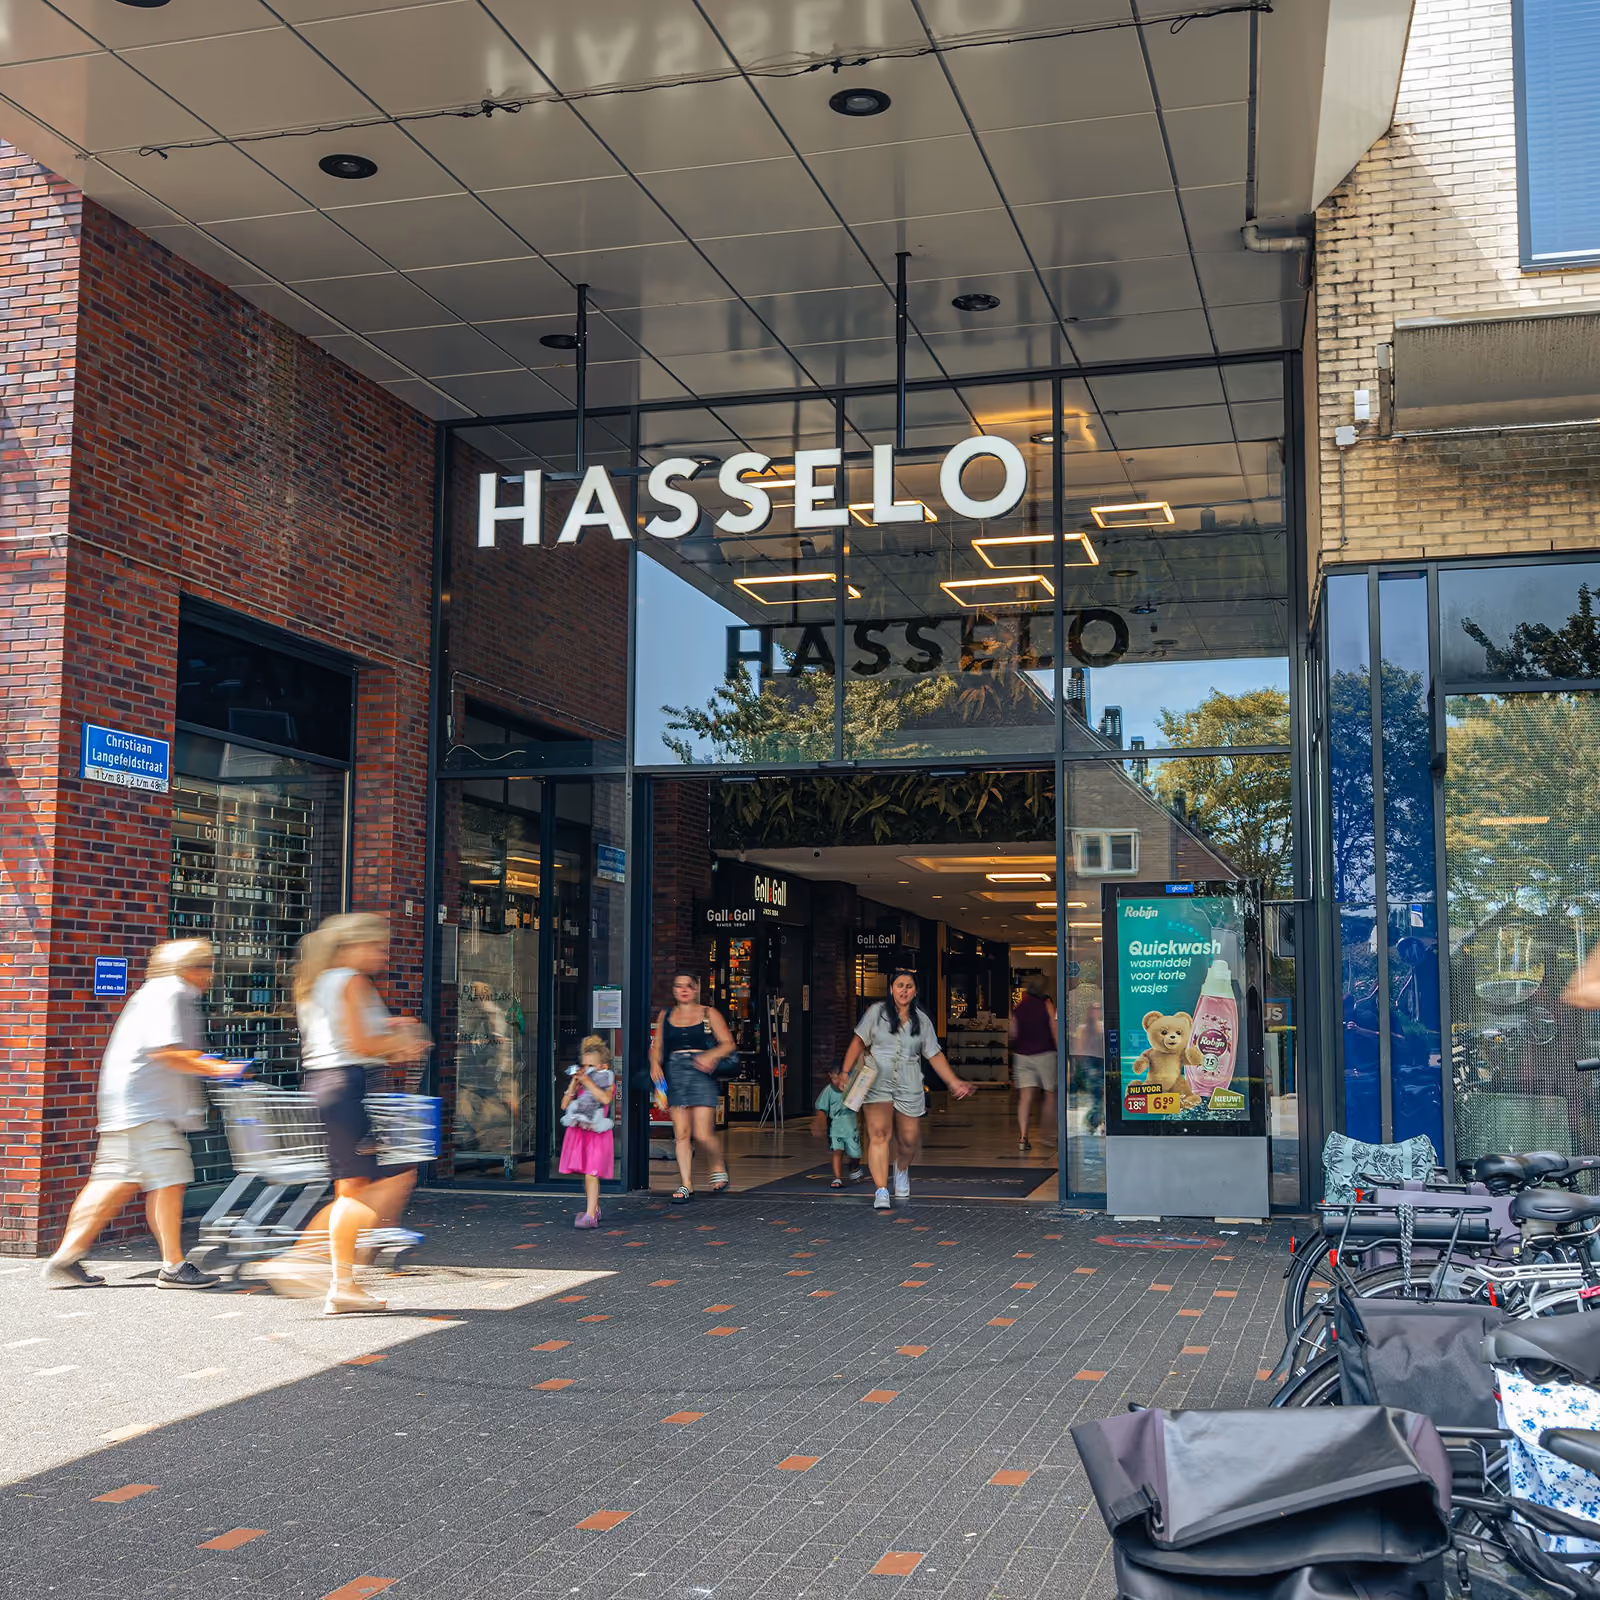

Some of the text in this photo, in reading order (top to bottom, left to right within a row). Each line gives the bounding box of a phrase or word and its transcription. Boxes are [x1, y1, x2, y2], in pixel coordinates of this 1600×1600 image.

[476, 435, 1028, 549] HASSELO
[106, 734, 152, 754] Christiaan
[92, 748, 163, 773] Langefeldstraat
[101, 772, 114, 782] t/m
[116, 774, 125, 784] 83
[130, 777, 135, 785] 2
[136, 777, 149, 788] t/m
[1171, 884, 1188, 893] global
[1124, 905, 1159, 919] Robijn
[1128, 940, 1221, 956] Quickwash
[1130, 957, 1191, 968] wasmiddel
[1130, 969, 1187, 981] voor korte
[1130, 983, 1168, 995] wasjes
[1205, 1058, 1215, 1066] 15
[1142, 1085, 1161, 1093] VOOR
[1214, 1095, 1241, 1103] NIEUW!
